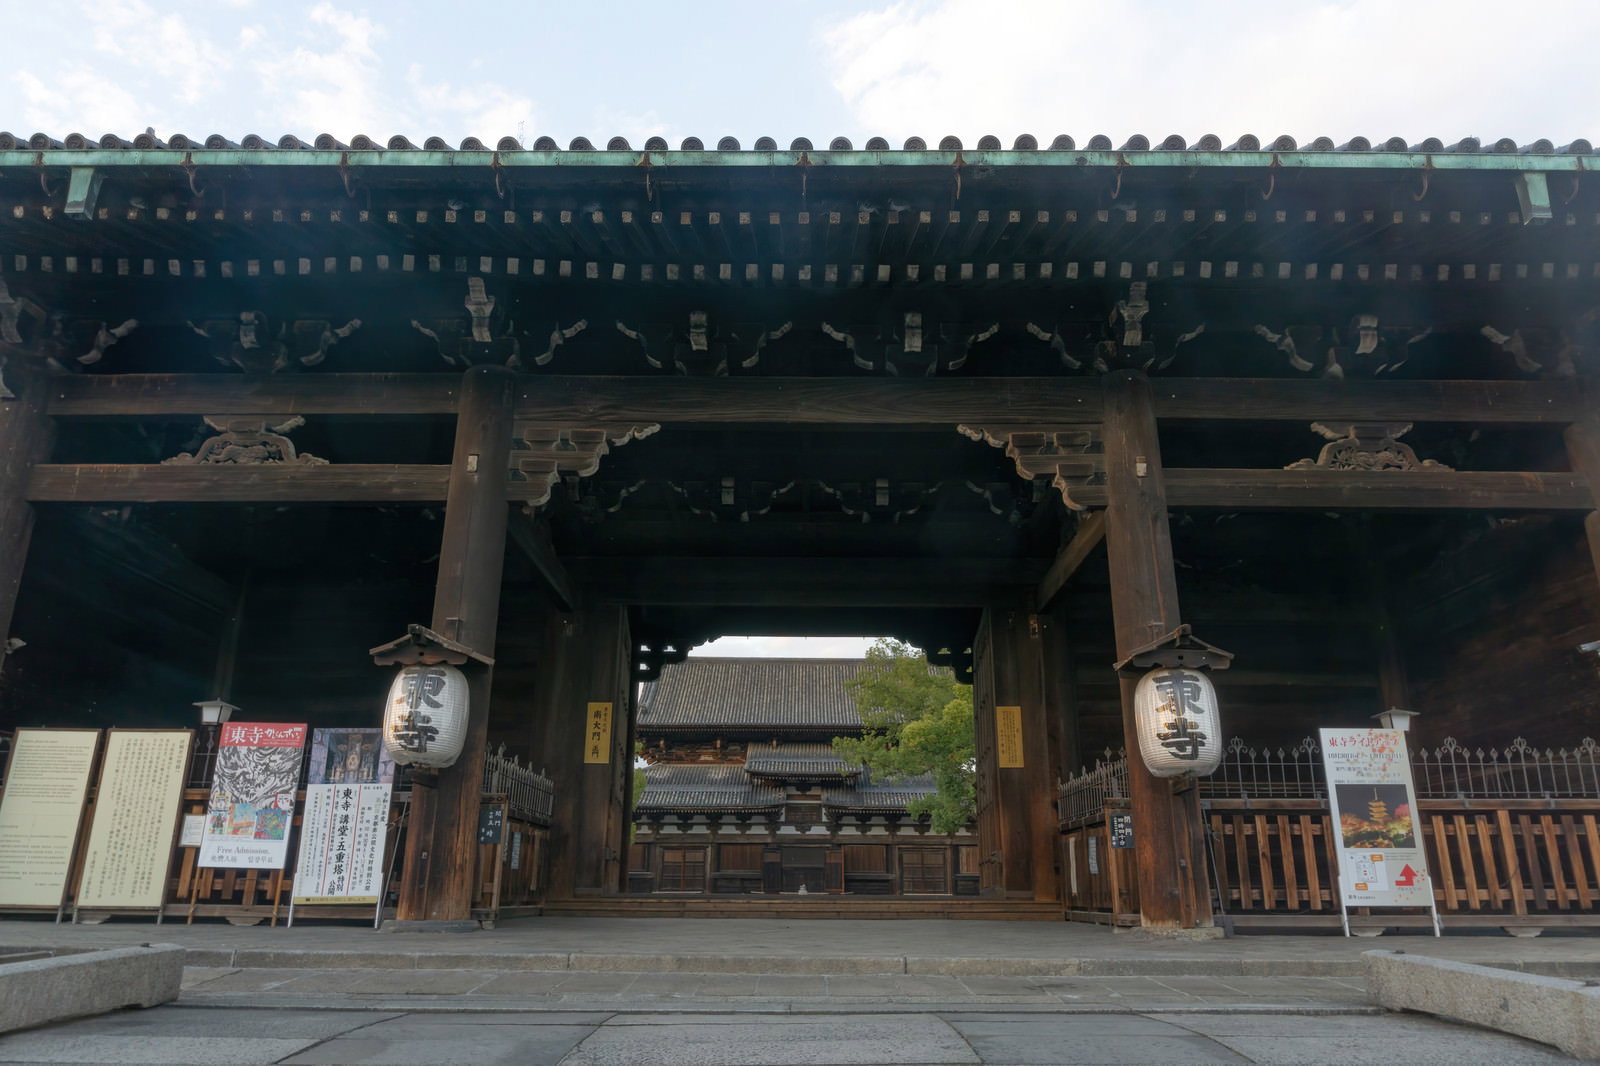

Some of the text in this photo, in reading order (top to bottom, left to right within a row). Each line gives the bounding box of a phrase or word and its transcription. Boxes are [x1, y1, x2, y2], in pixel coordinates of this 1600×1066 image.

[391, 668, 447, 753] 東寺
[1152, 670, 1207, 760] 東寺
[217, 846, 232, 854] Free
